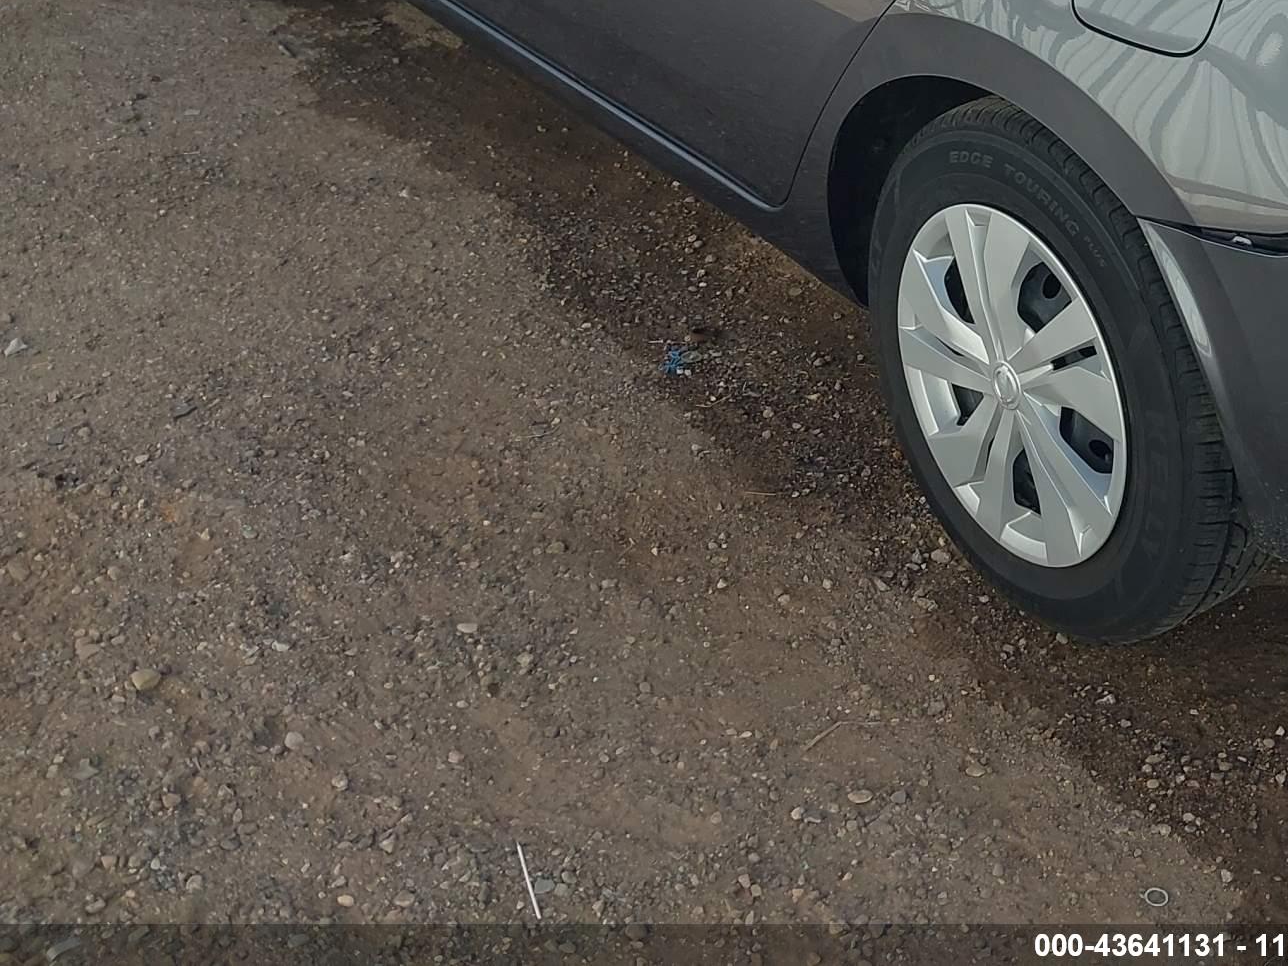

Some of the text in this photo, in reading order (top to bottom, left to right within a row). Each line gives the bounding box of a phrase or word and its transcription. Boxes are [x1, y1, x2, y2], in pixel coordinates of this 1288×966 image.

[949, 150, 1106, 268] EDGE TOURING PLUS
